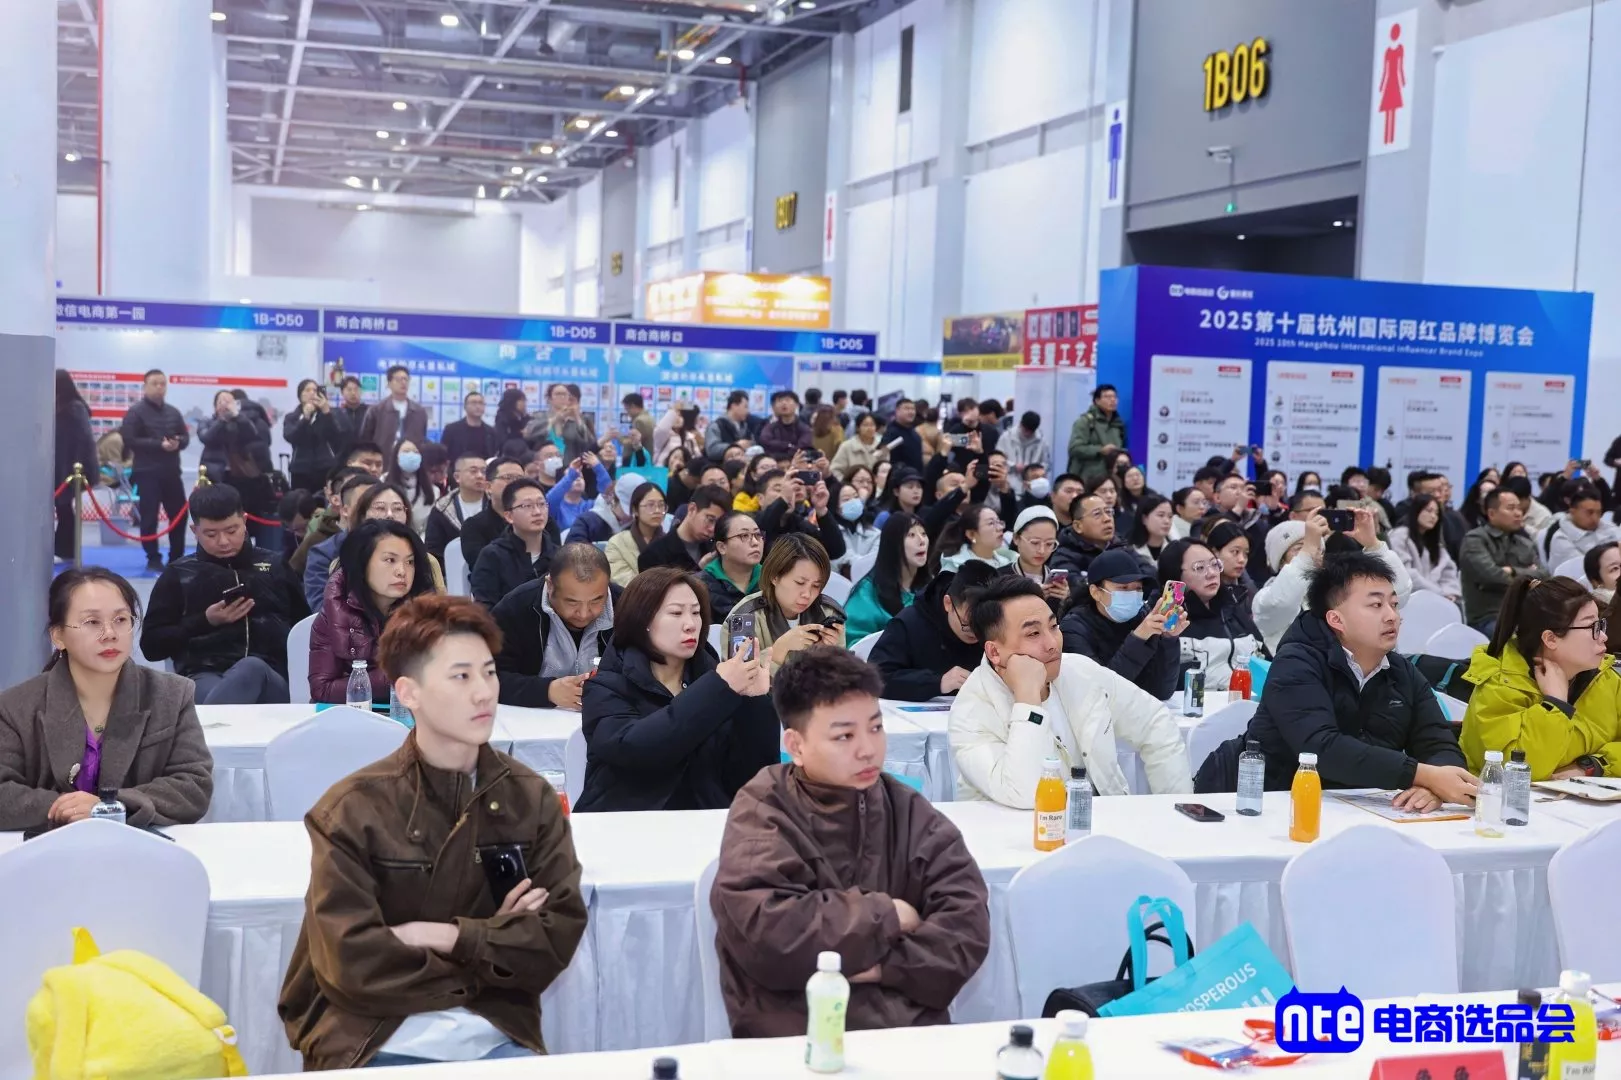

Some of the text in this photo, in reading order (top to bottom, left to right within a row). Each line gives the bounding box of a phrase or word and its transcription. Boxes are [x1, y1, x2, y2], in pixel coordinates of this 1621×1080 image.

[1204, 37, 1268, 112] 1B06
[253, 312, 304, 327] 1B-D50
[550, 325, 597, 339] 1B-D05
[821, 337, 863, 350] 1B-D05
